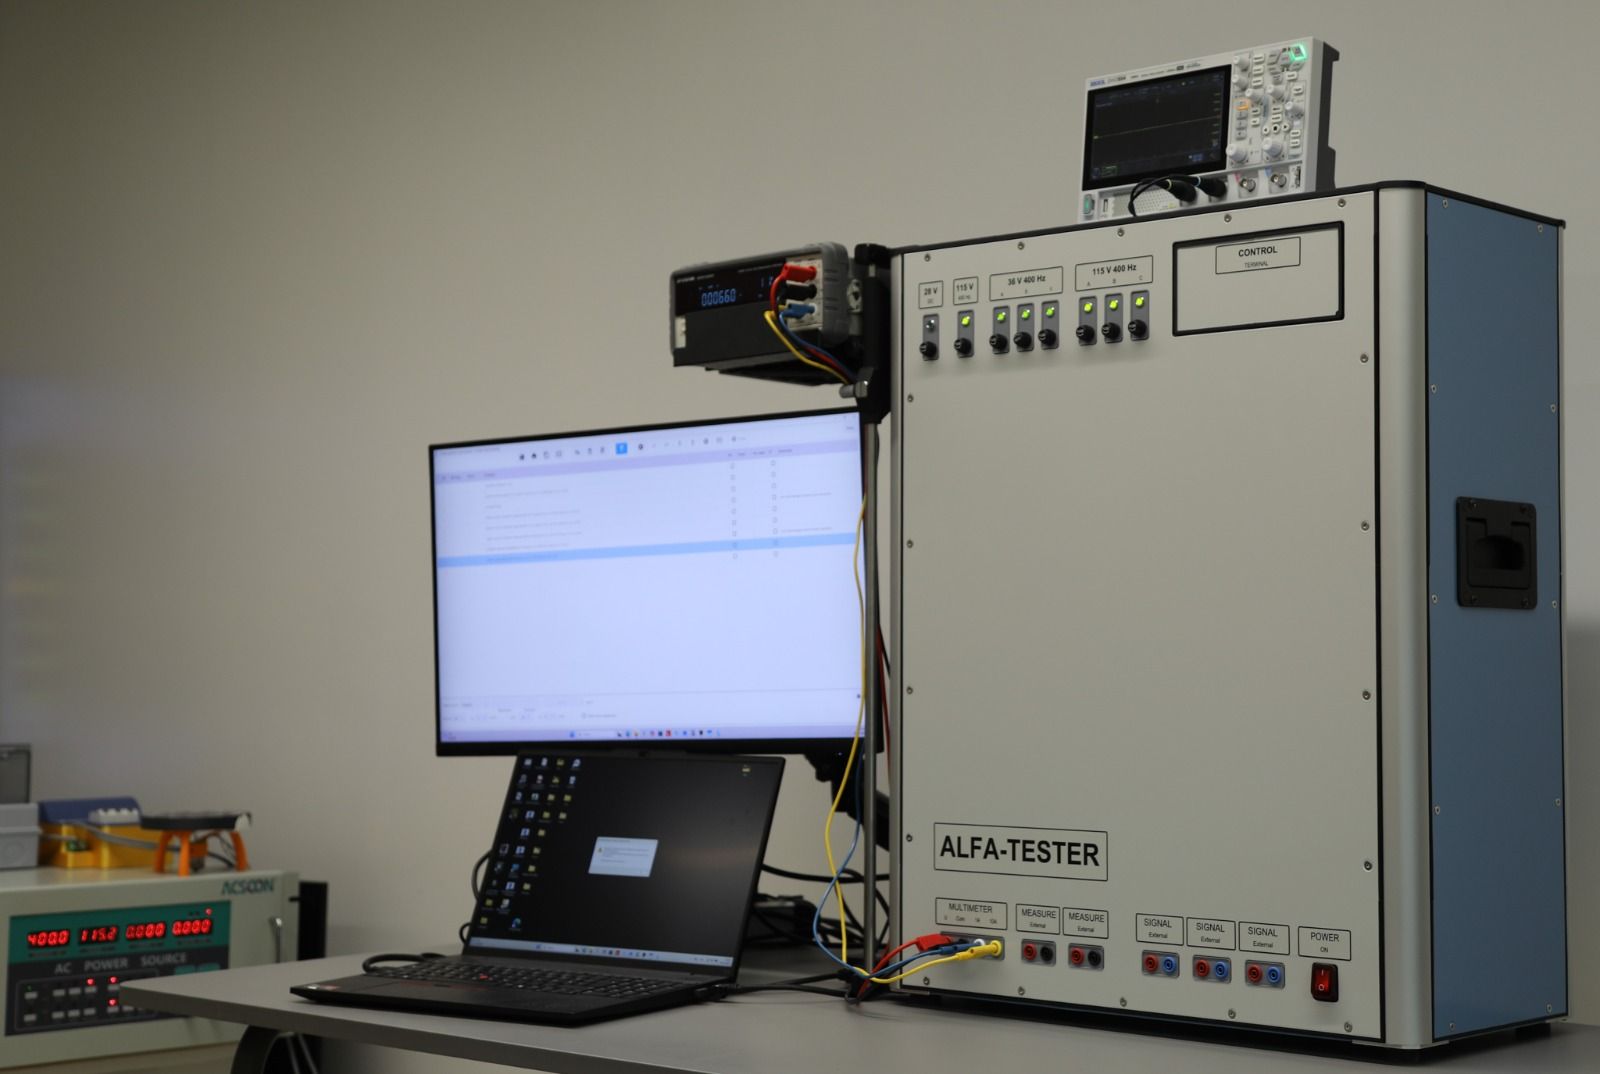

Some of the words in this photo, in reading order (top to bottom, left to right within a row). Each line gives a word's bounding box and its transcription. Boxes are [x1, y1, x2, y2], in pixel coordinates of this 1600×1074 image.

[1238, 246, 1278, 257] CONTROL
[1092, 267, 1105, 275] 115
[1106, 265, 1111, 274] V
[1112, 264, 1126, 273] 400
[1017, 276, 1023, 285] V
[1023, 275, 1036, 284] 400
[1037, 274, 1046, 283] Hz
[956, 283, 968, 292] 115
[940, 835, 1100, 866] ALFA-TESTER
[948, 903, 993, 913] MULTIMETER
[1021, 908, 1057, 919] MEASURE
[1068, 912, 1105, 923] MEASURE
[1143, 918, 1172, 929] SIGNAL
[1196, 922, 1225, 933] SIGNAL
[1148, 931, 1168, 939] External
[1247, 926, 1278, 937] SIGNAL
[1310, 932, 1340, 942] POWER
[1200, 936, 1221, 944] External
[54, 963, 73, 974] AC
[84, 957, 129, 972] POWER
[141, 952, 188, 967] SOURCE
